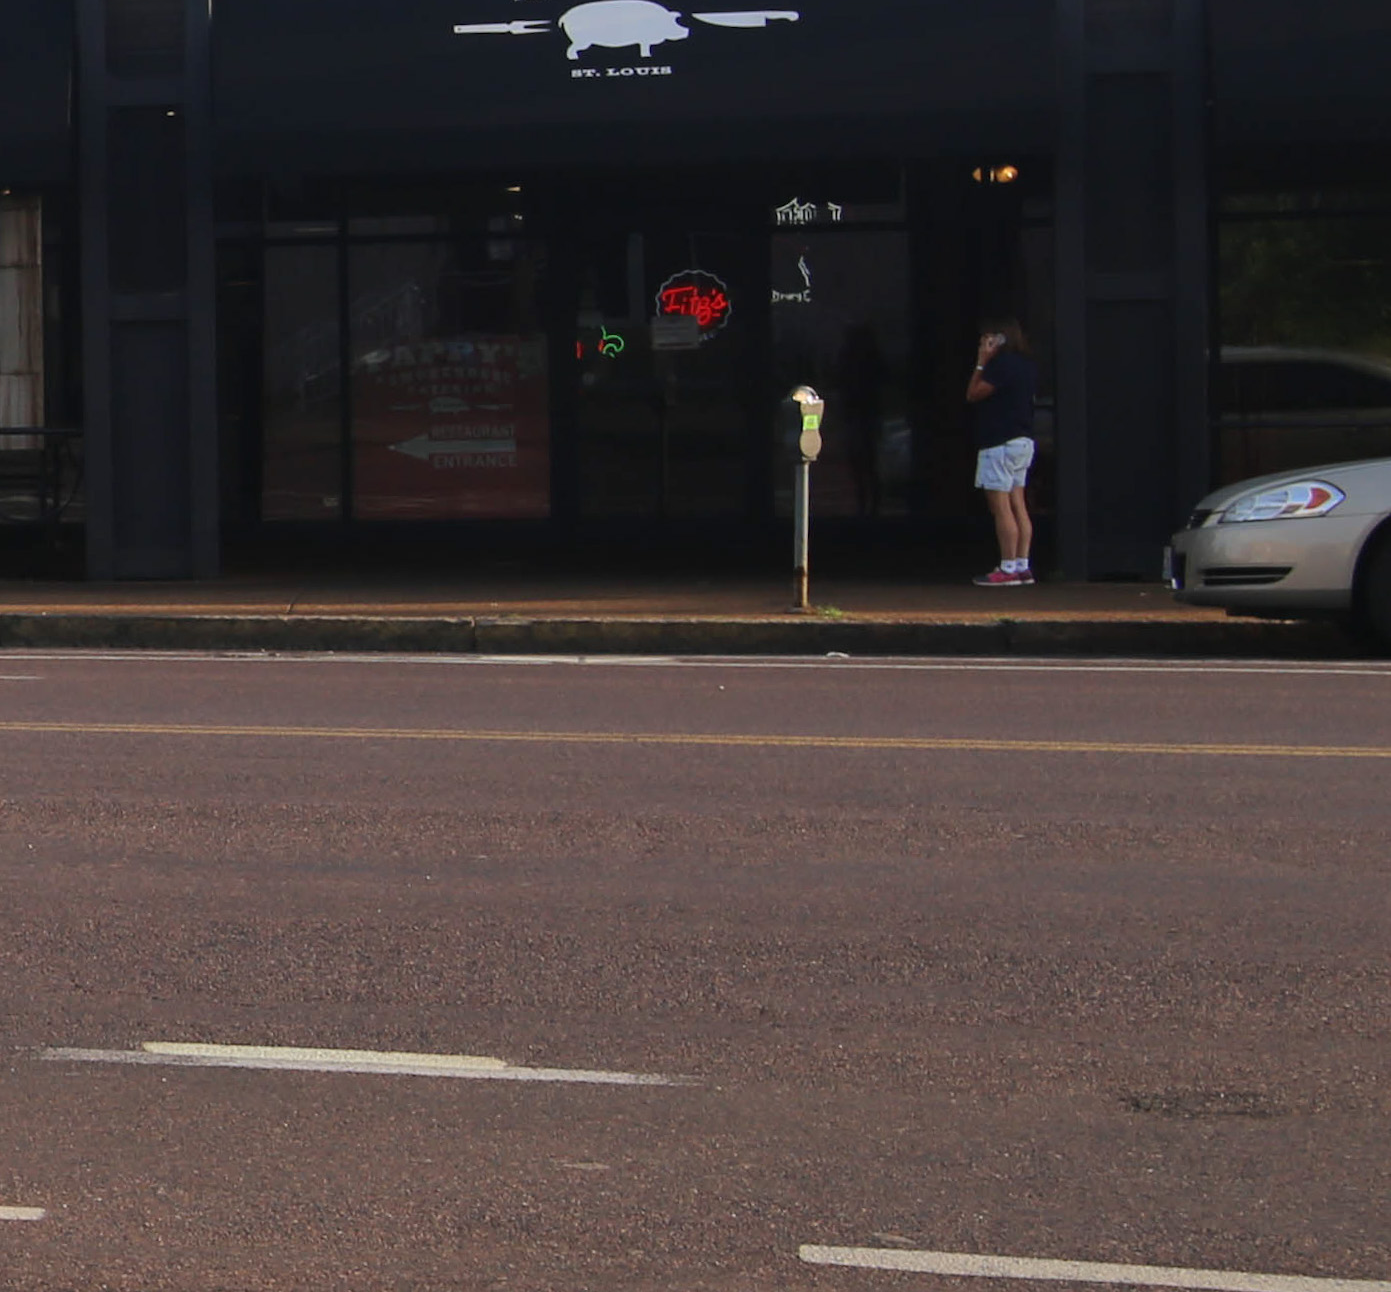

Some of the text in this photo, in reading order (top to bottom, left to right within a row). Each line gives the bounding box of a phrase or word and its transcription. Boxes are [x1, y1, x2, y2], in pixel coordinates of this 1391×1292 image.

[570, 65, 673, 78] ST. LOUIS
[433, 453, 518, 469] ENTRANCE
